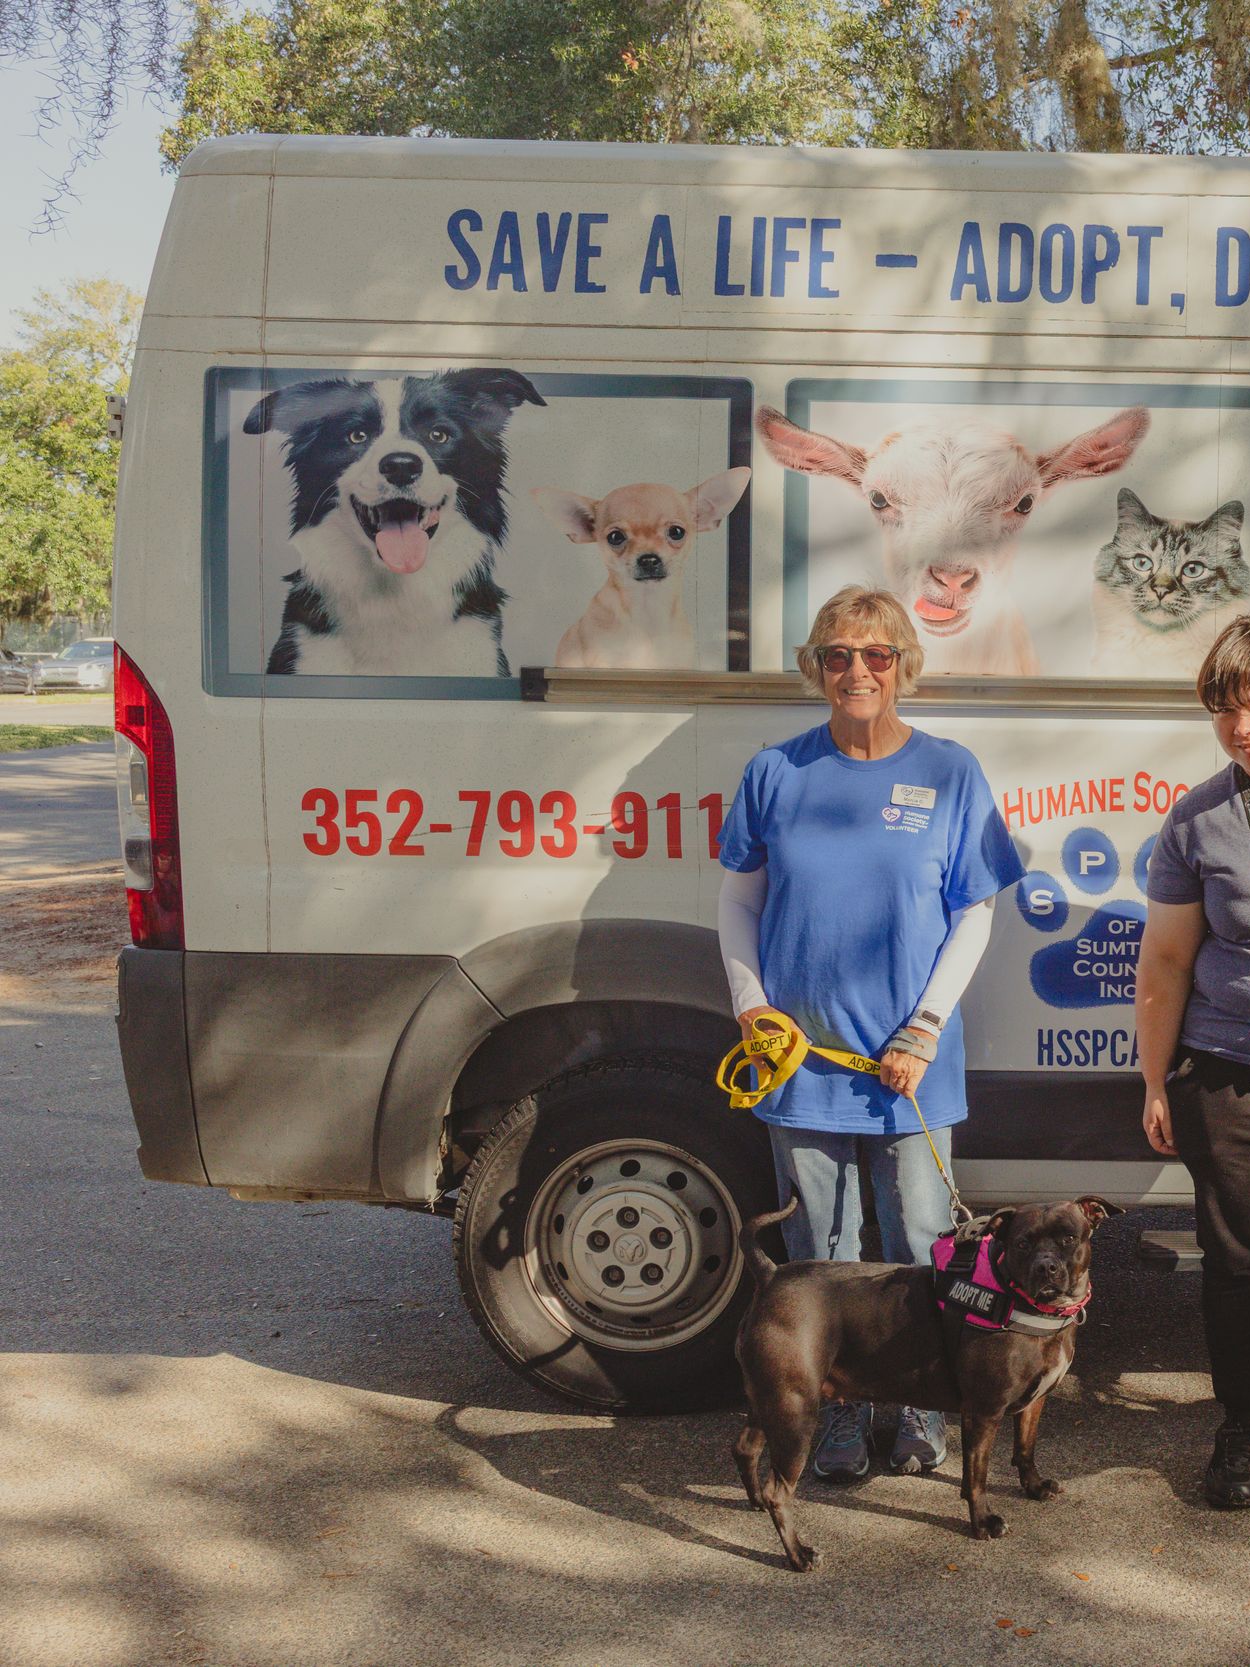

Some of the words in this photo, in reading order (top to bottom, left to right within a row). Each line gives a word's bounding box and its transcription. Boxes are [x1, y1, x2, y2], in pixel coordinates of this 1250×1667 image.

[444, 208, 608, 294] SAVE
[639, 214, 681, 296] A
[714, 215, 842, 298] LIFE
[950, 221, 1186, 316] ADOPT,
[1003, 776, 1125, 832] HUMANE
[1028, 889, 1055, 915] S
[1079, 851, 1106, 875] P
[1107, 920, 1139, 935] OF
[1076, 939, 1140, 956] SUMT
[750, 1034, 785, 1053] ADOPT
[949, 1281, 980, 1305] ADOPT
[976, 1291, 994, 1312] ME
